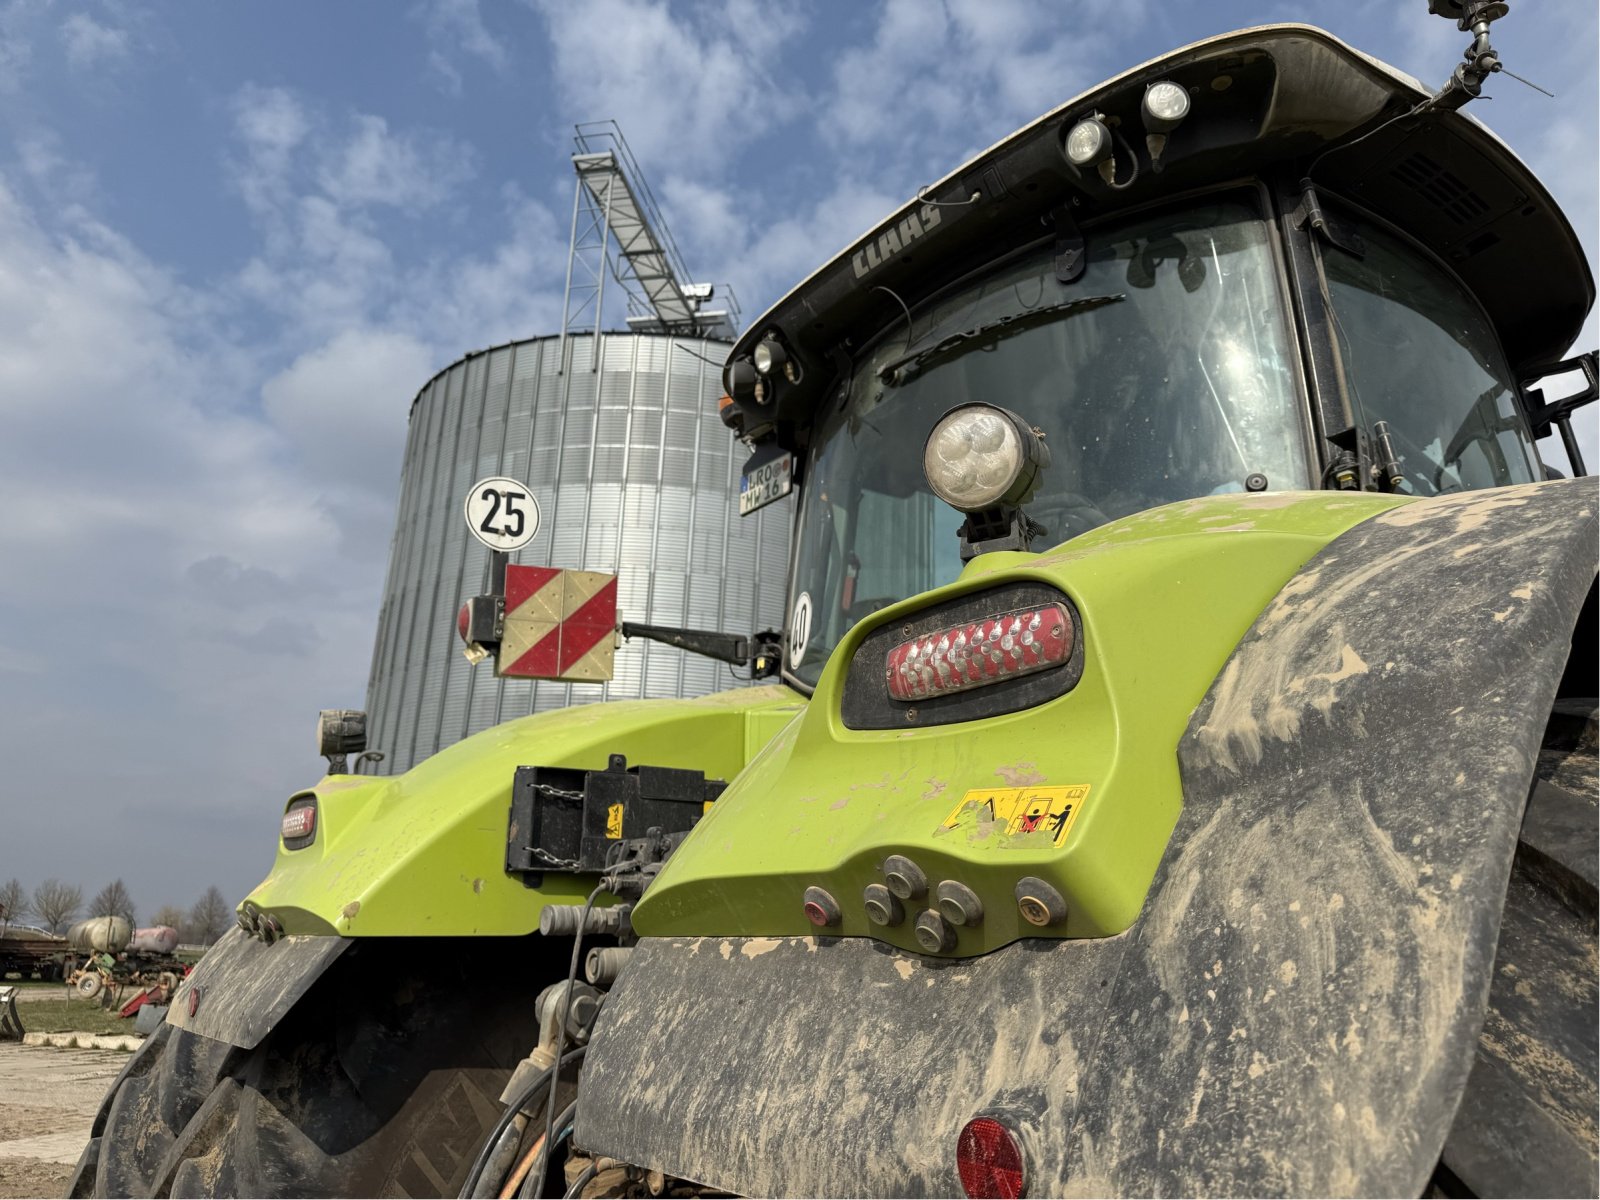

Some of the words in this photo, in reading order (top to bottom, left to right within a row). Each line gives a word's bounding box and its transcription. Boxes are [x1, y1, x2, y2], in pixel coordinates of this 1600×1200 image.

[851, 198, 941, 279] CLAAS
[749, 464, 772, 490] LRO
[764, 479, 779, 500] 16
[480, 488, 525, 537] 25
[792, 603, 807, 655] 40
